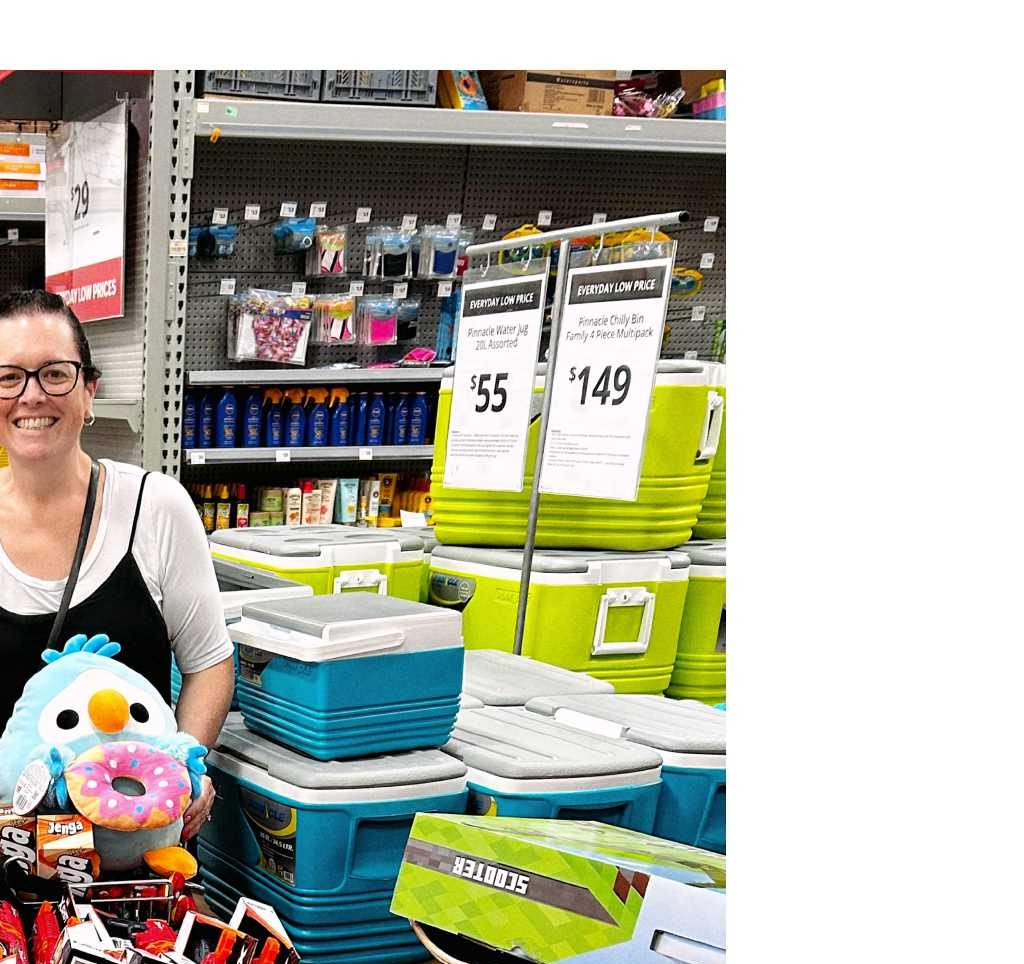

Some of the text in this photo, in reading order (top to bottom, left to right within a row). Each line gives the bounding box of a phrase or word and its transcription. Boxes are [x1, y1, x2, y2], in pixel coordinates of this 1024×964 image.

[70, 180, 90, 221] $29
[78, 285, 93, 301] LOW
[93, 278, 117, 299] PRICES
[577, 278, 656, 297] EVERYDAY LOW PRICE
[469, 292, 534, 310] EVERYDAY LOW PRICE
[579, 312, 644, 327] Pinnacle Chilly Bin
[468, 325, 495, 337] Pinnacle
[496, 324, 516, 335] Water
[566, 326, 654, 343] Family 4 Piece Multipack
[489, 338, 518, 350] Assorted
[470, 372, 508, 413] $55
[568, 364, 632, 406] $149
[48, 820, 83, 834] Jenga
[454, 856, 530, 895] SCOOTER
